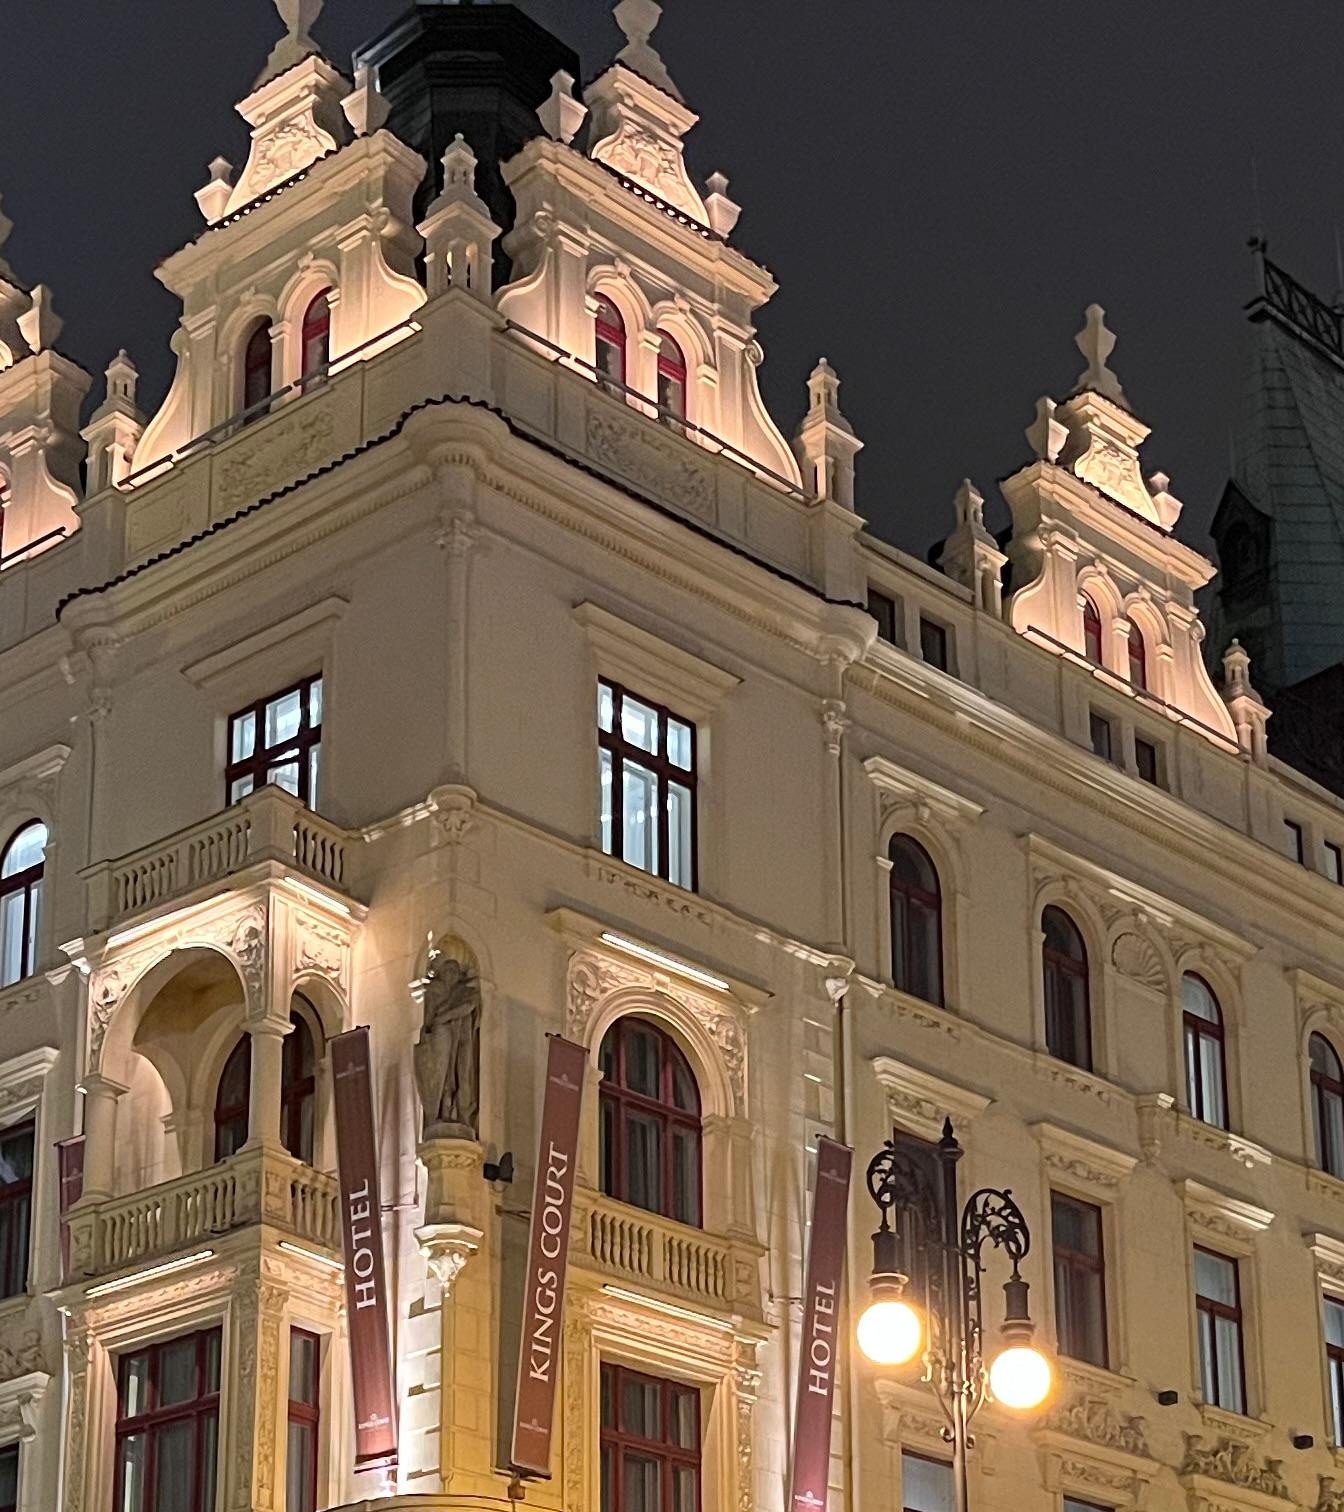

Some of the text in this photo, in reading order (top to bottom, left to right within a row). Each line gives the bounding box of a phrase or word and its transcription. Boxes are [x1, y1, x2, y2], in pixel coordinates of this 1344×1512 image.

[349, 1178, 377, 1311] HOTEL
[540, 1141, 569, 1260] COURT
[529, 1267, 558, 1383] KINGS
[808, 1279, 836, 1397] HOTEL
